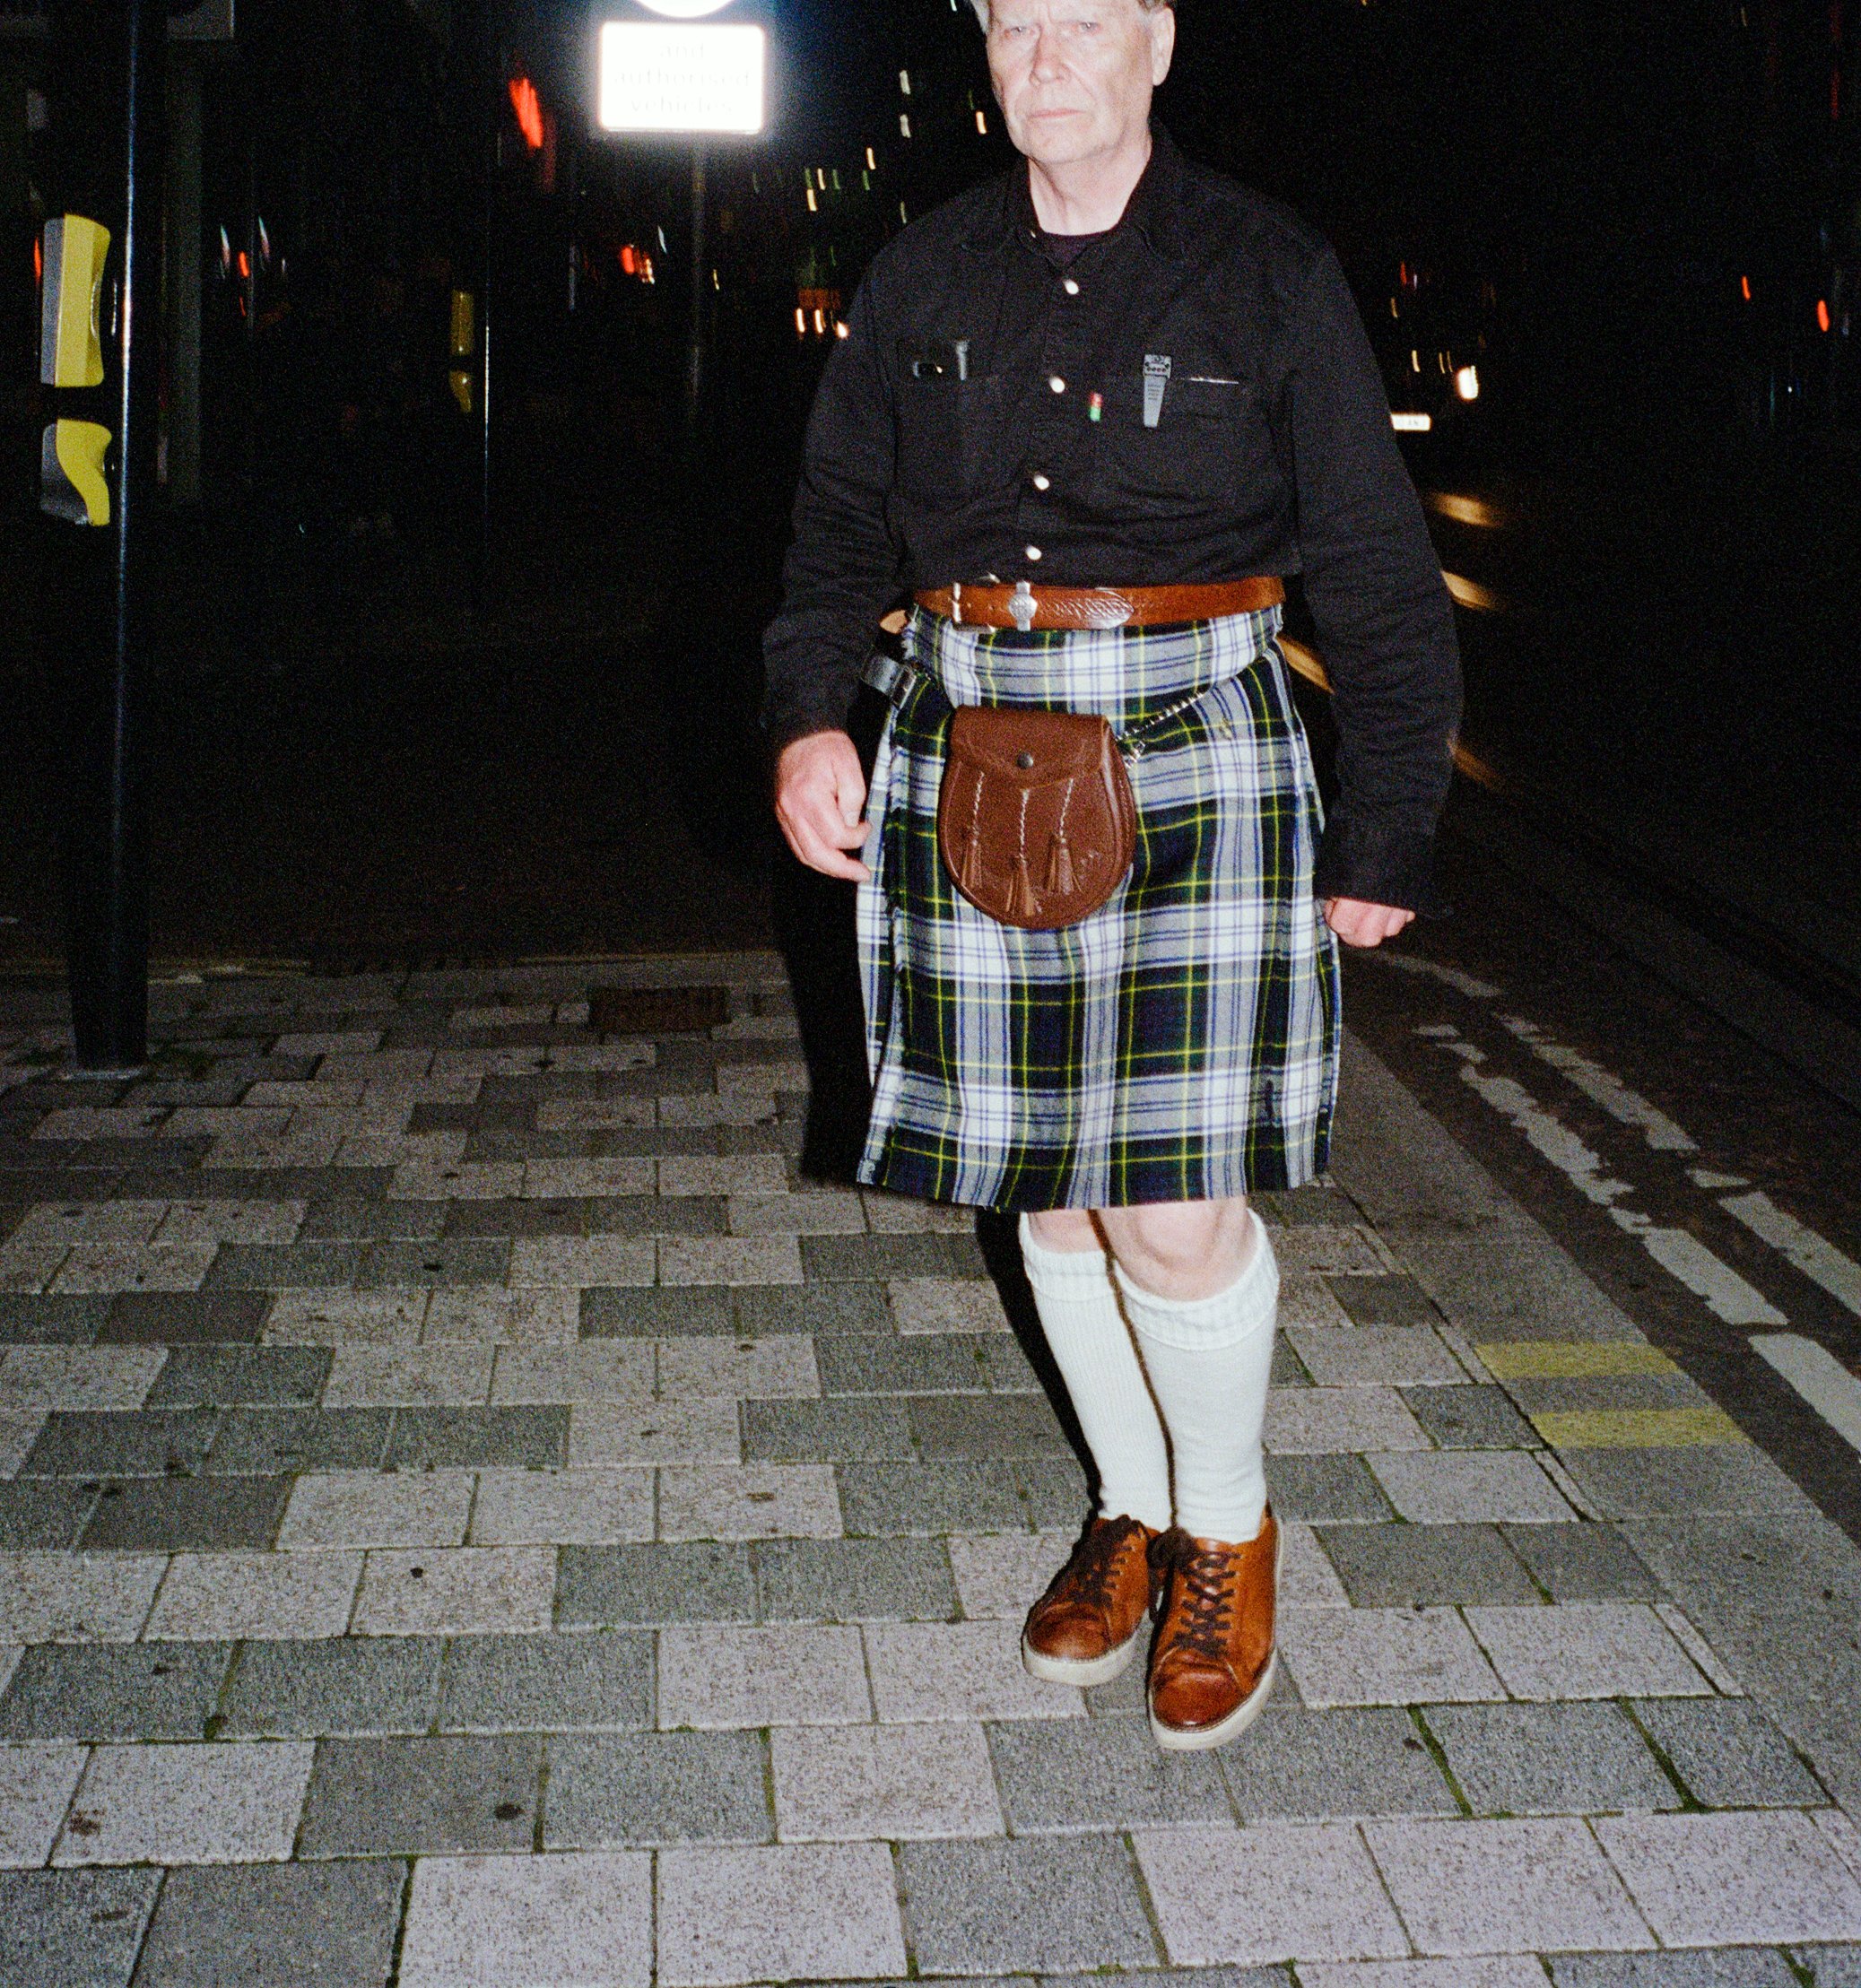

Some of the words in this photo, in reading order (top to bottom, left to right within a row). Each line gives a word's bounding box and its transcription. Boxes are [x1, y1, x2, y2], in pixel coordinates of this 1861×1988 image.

[660, 39, 705, 58] and
[613, 65, 751, 87] authorised
[630, 94, 733, 115] vehicles
